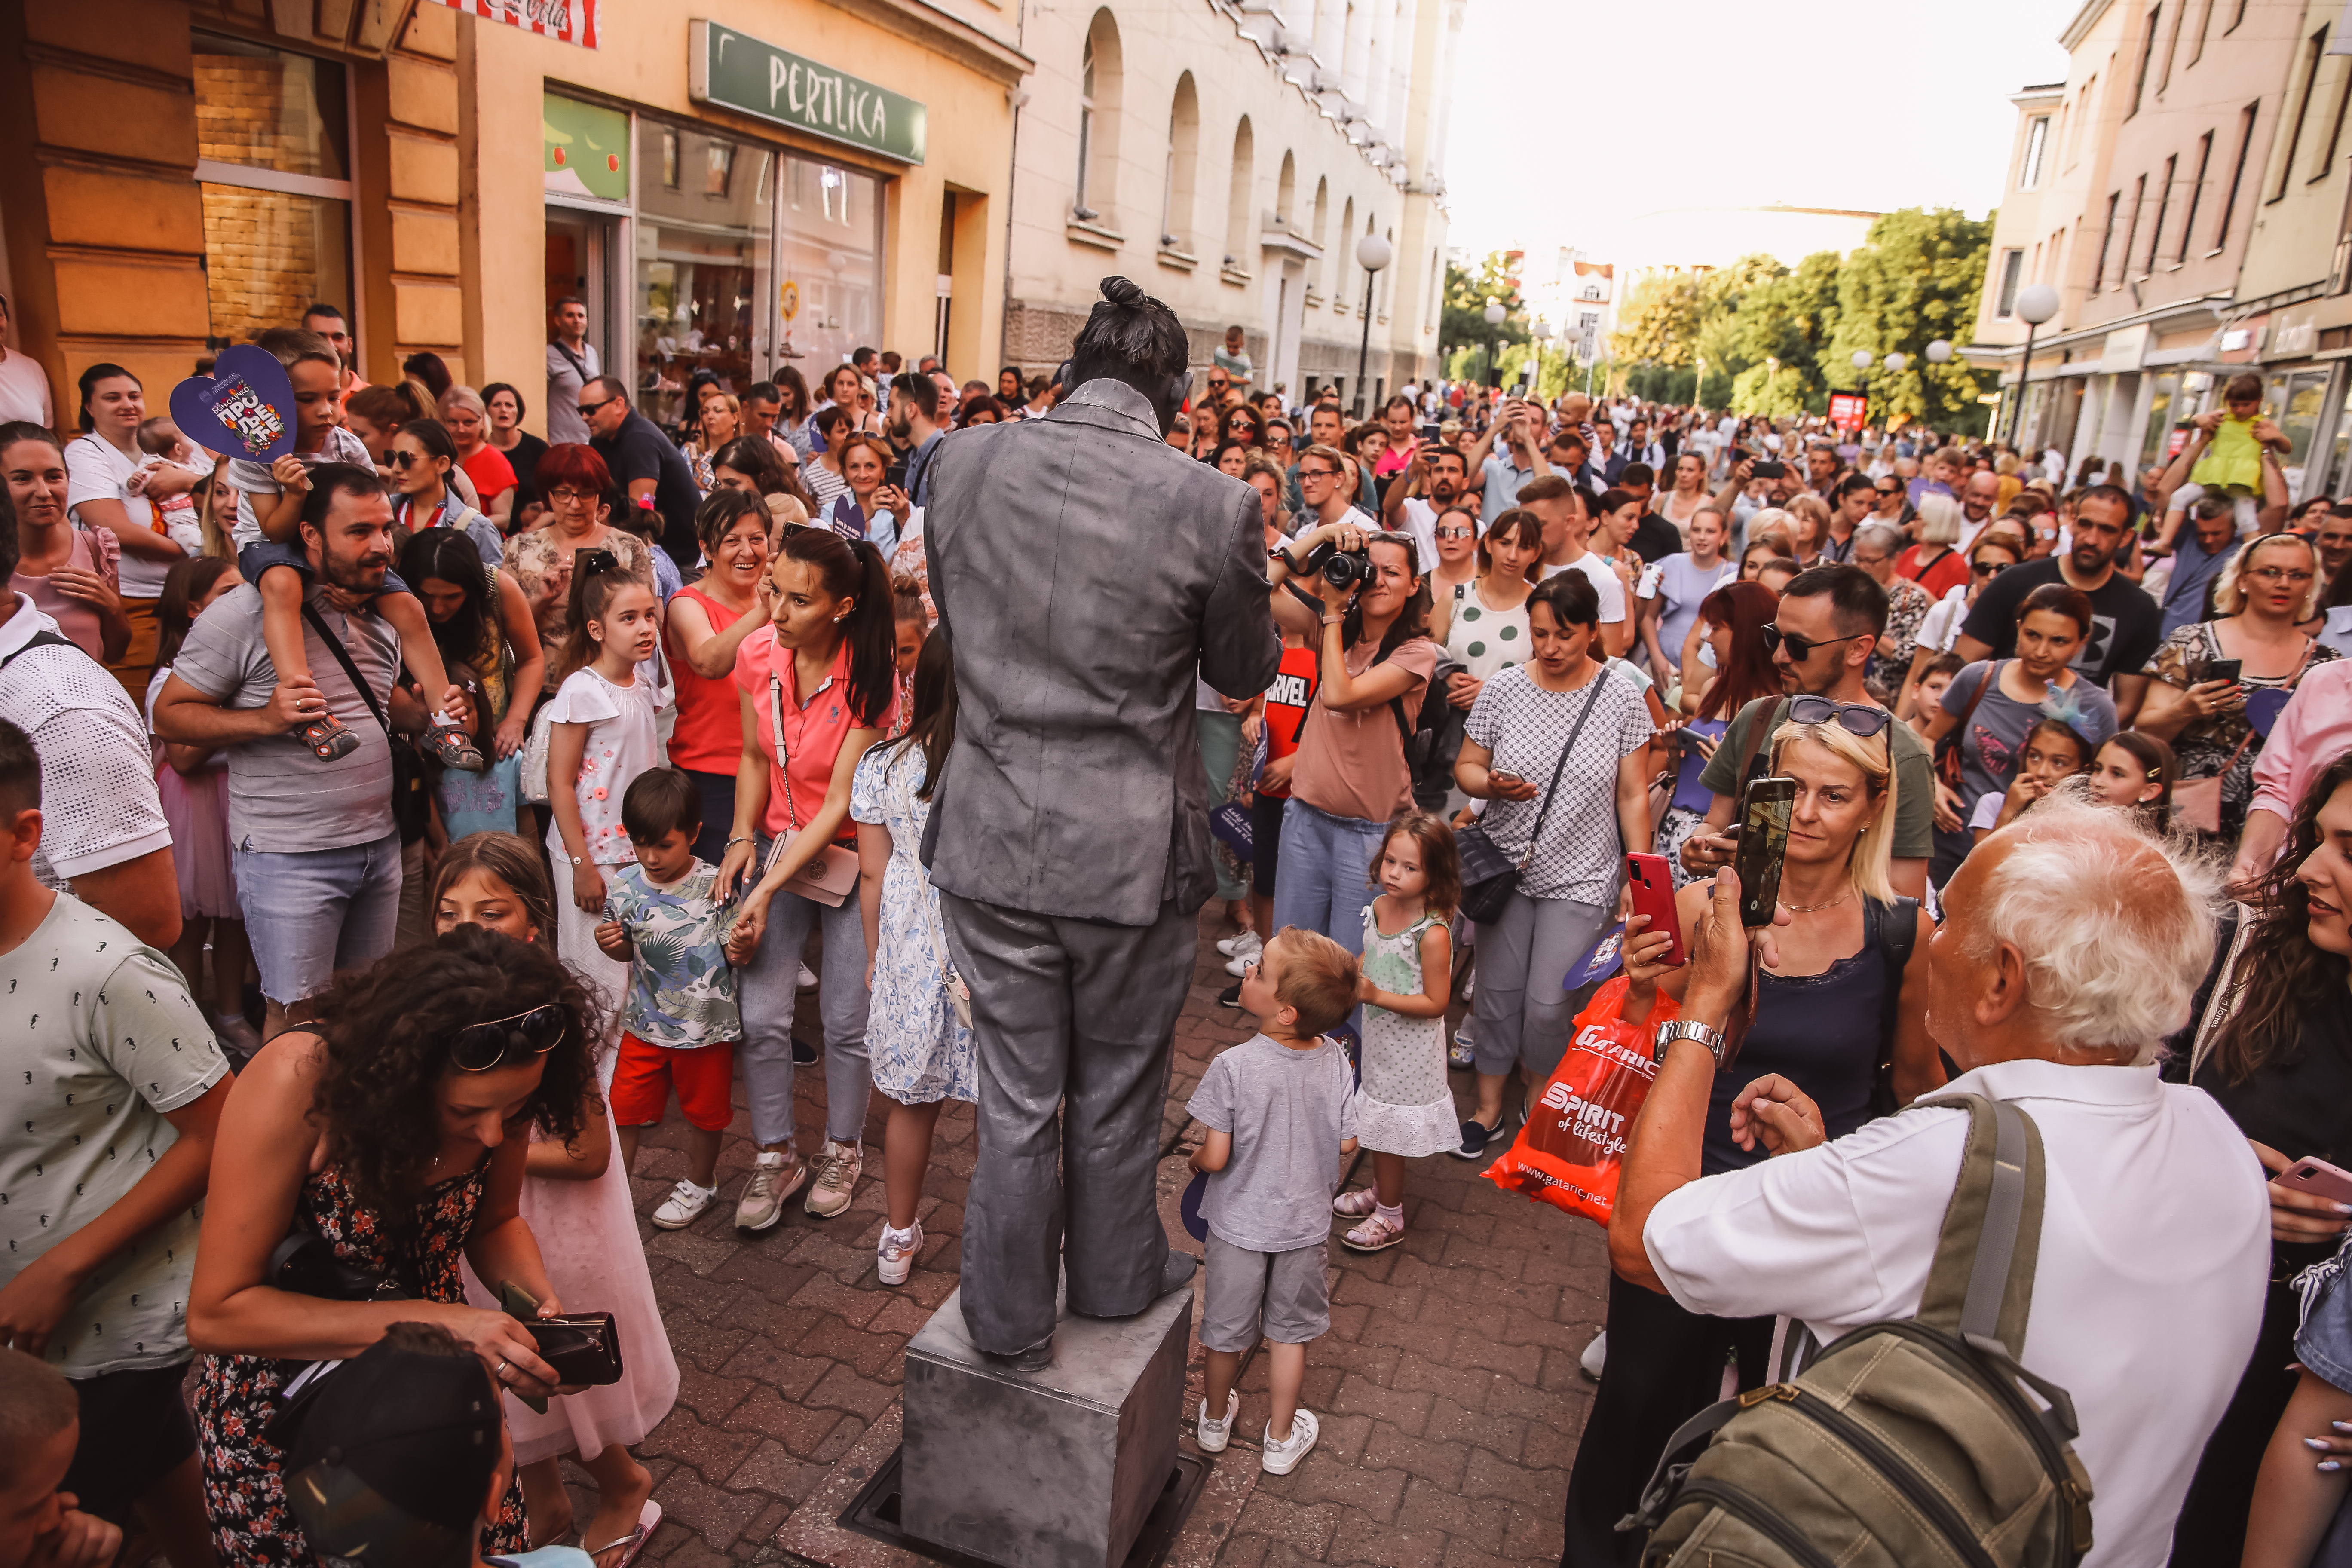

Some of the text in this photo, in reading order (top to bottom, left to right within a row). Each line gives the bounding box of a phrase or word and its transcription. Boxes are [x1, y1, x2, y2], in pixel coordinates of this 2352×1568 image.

[1265, 674, 1306, 707] ARVEL
[1575, 1024, 1660, 1076] GATARIC
[1540, 1081, 1625, 1133] SPIRIT
[1558, 1117, 1627, 1155] of lifestyle
[1517, 1161, 1608, 1206] www.gataric.net
